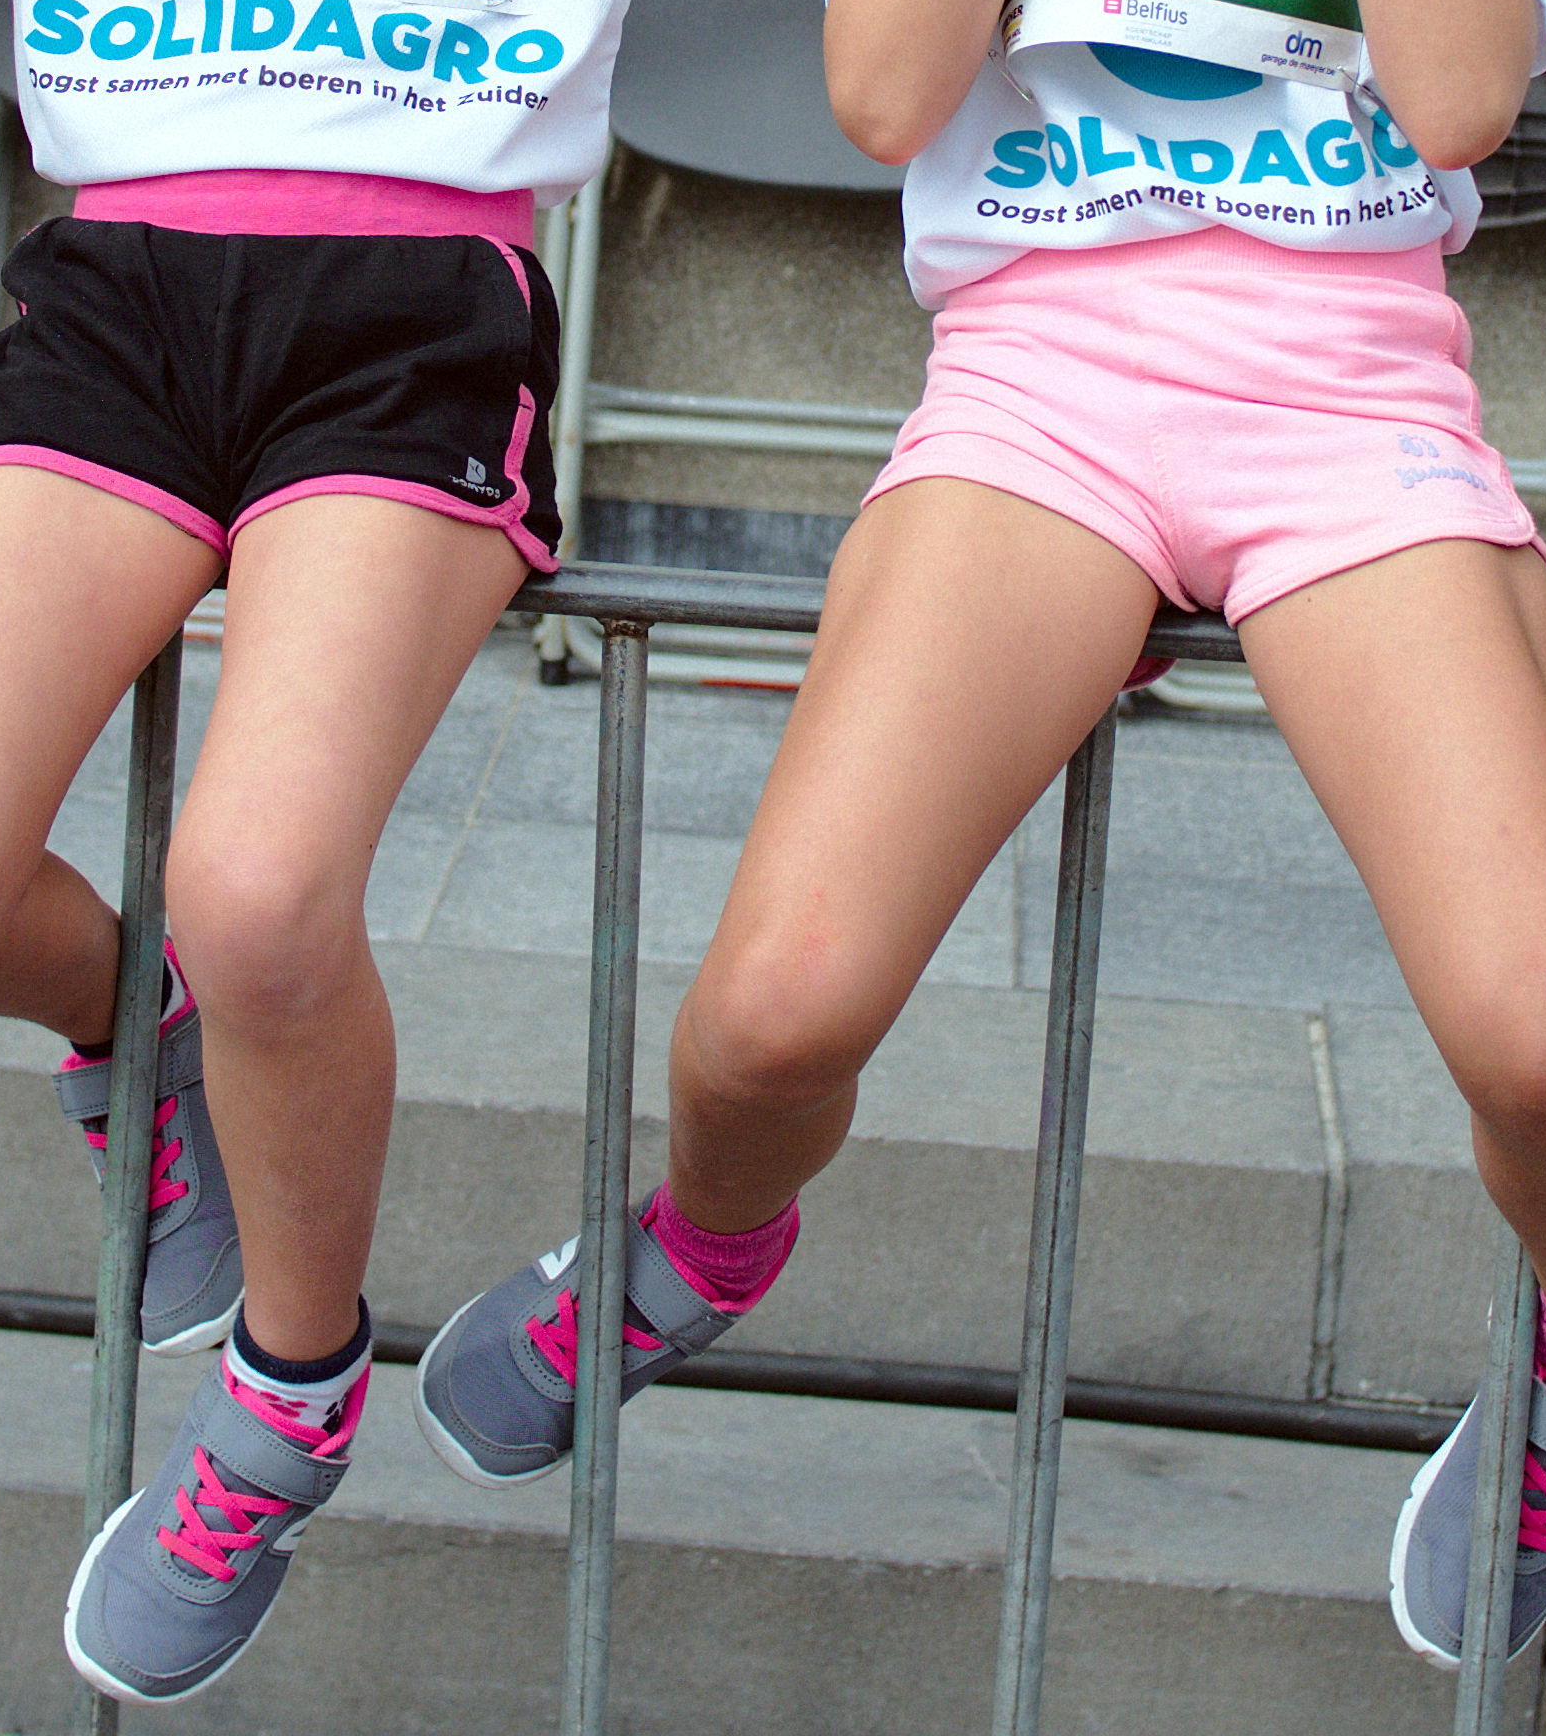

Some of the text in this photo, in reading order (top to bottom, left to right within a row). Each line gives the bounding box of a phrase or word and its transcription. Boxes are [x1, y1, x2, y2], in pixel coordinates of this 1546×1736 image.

[1285, 30, 1322, 59] dm
[106, 75, 190, 94] samen
[197, 67, 248, 87] met
[258, 65, 362, 94] boeren
[373, 80, 397, 101] in
[403, 86, 446, 112] het
[984, 107, 1419, 188] SOLIDAGO
[976, 198, 1068, 224] Oogst
[1074, 186, 1143, 223] samen
[1150, 184, 1206, 210] met
[1215, 196, 1315, 226] boeren
[1326, 205, 1351, 226] in
[1359, 196, 1394, 222] het
